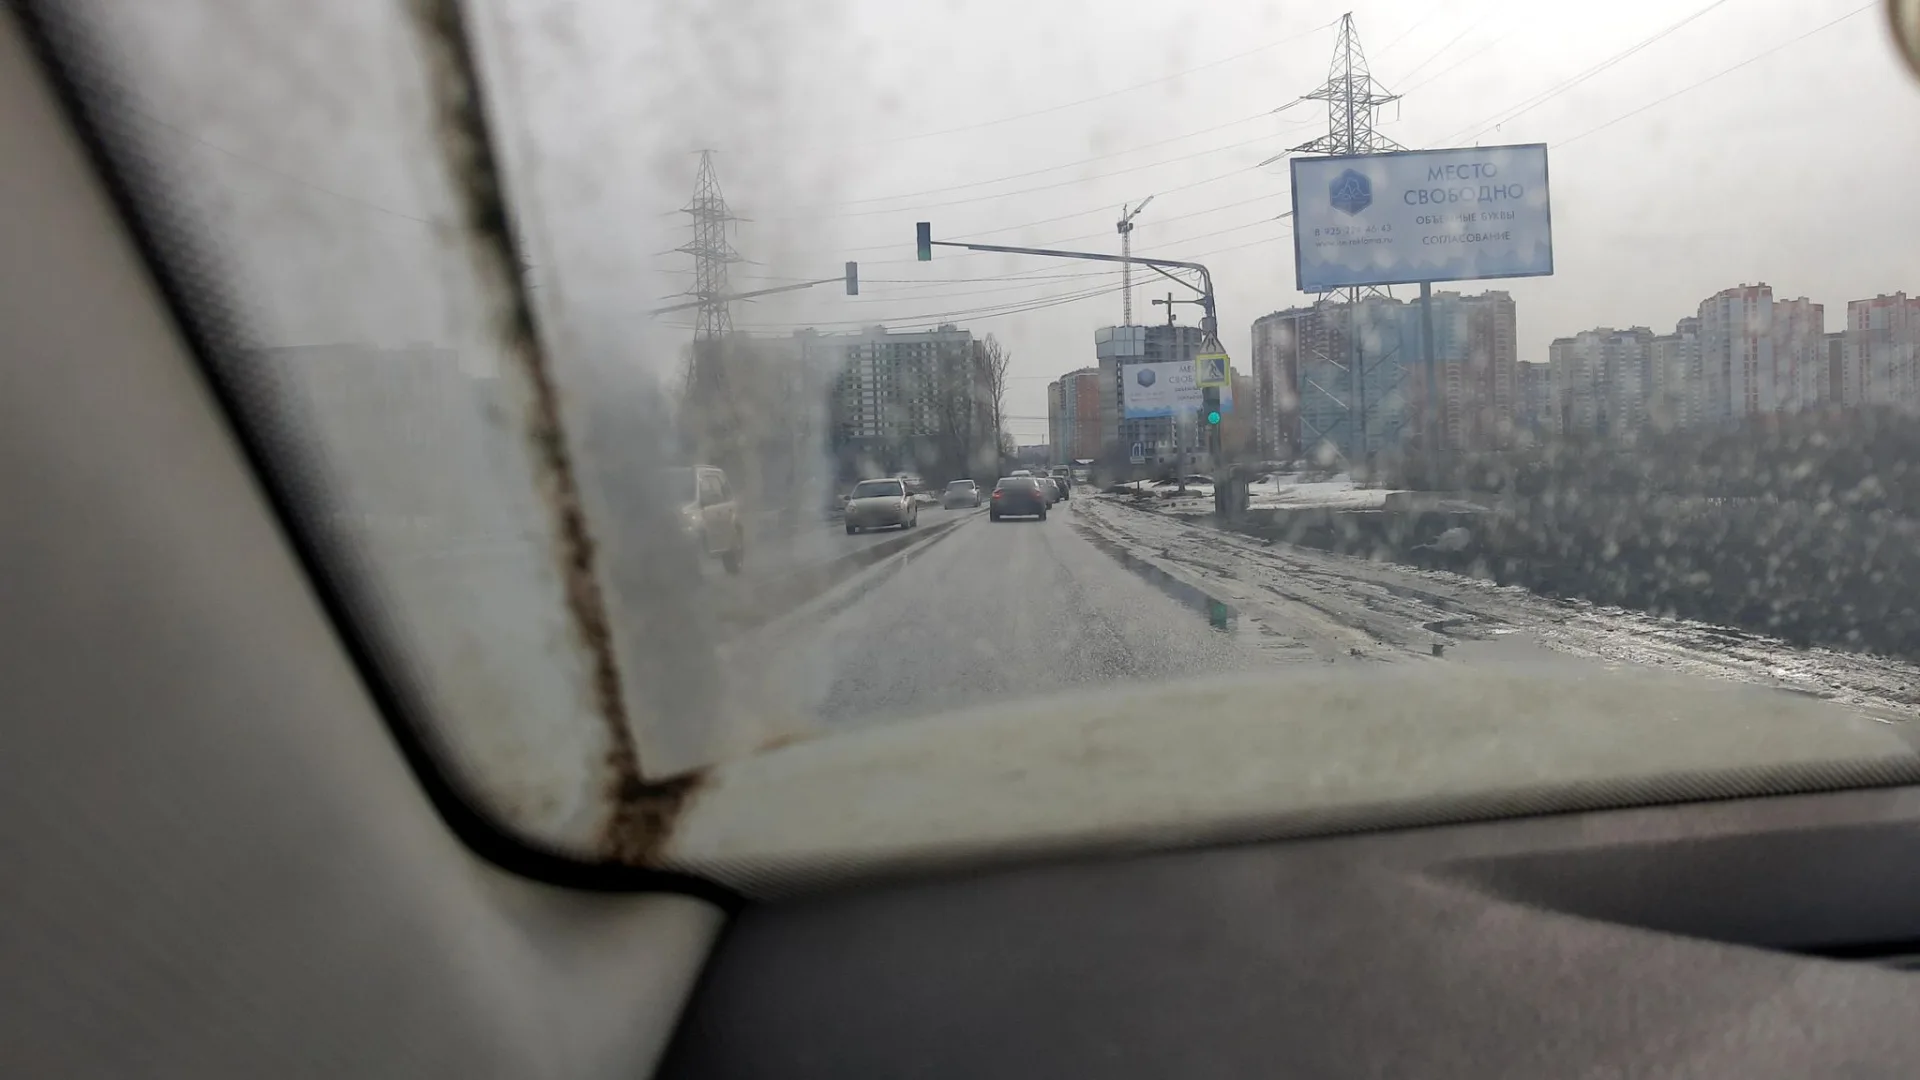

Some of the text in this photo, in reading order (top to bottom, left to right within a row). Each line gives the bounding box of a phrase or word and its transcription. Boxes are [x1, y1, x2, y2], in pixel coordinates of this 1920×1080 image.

[1427, 162, 1497, 182] МЕСТО
[1403, 183, 1524, 205] СВОБОДНО
[1415, 210, 1515, 225] ОБЪЕНЫЕ БУКВЫ
[1422, 231, 1511, 246] СОГЛАСОВАНИЕ
[1169, 374, 1193, 384] СВОБ
